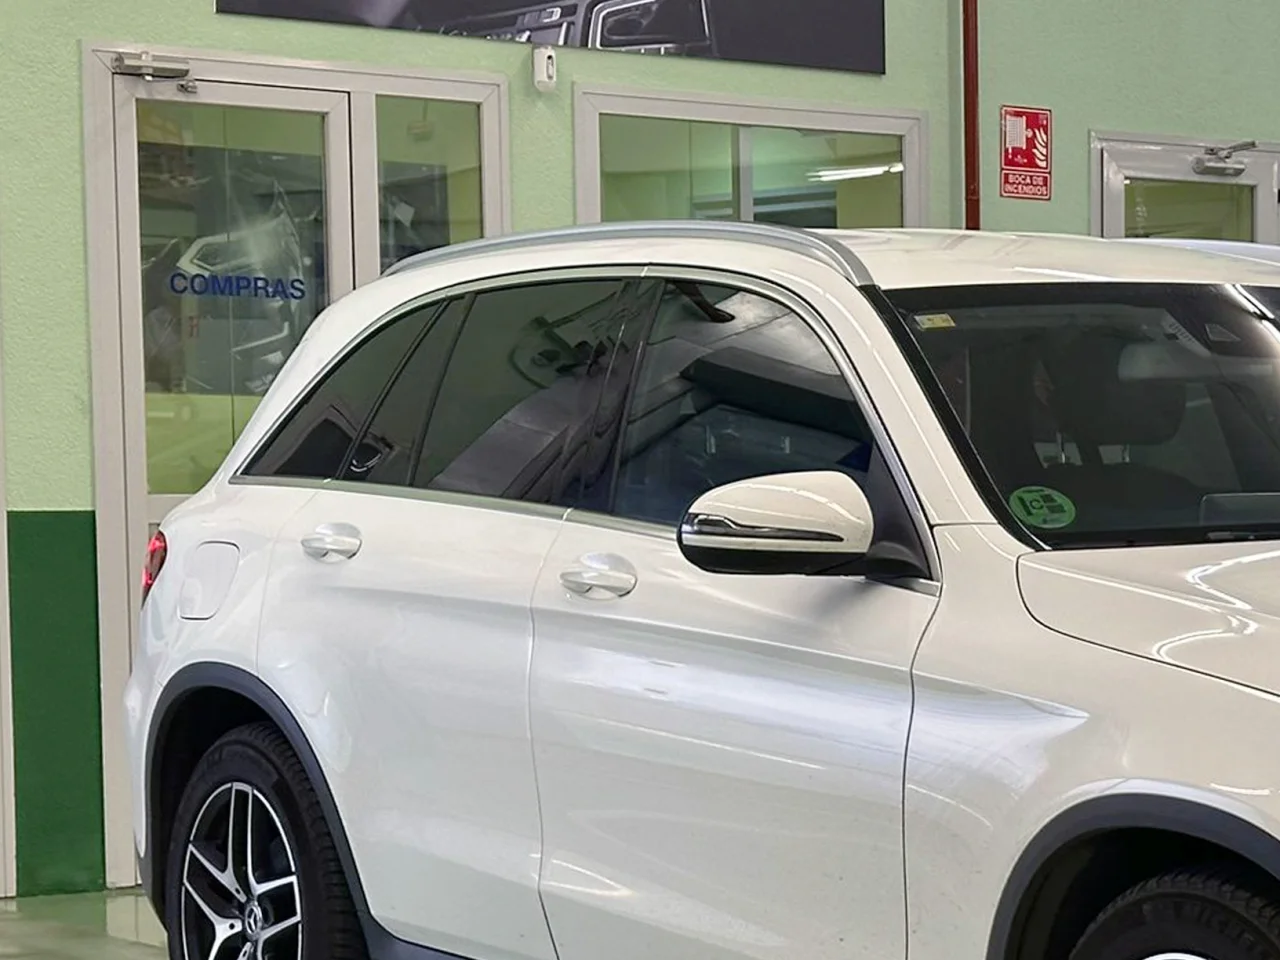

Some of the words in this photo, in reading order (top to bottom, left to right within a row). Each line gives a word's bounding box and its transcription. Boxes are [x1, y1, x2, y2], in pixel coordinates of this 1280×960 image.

[1008, 175, 1031, 184] BOCA
[1032, 176, 1044, 185] DE
[1005, 184, 1047, 195] INCENDIOS
[170, 271, 306, 301] COMPRAS
